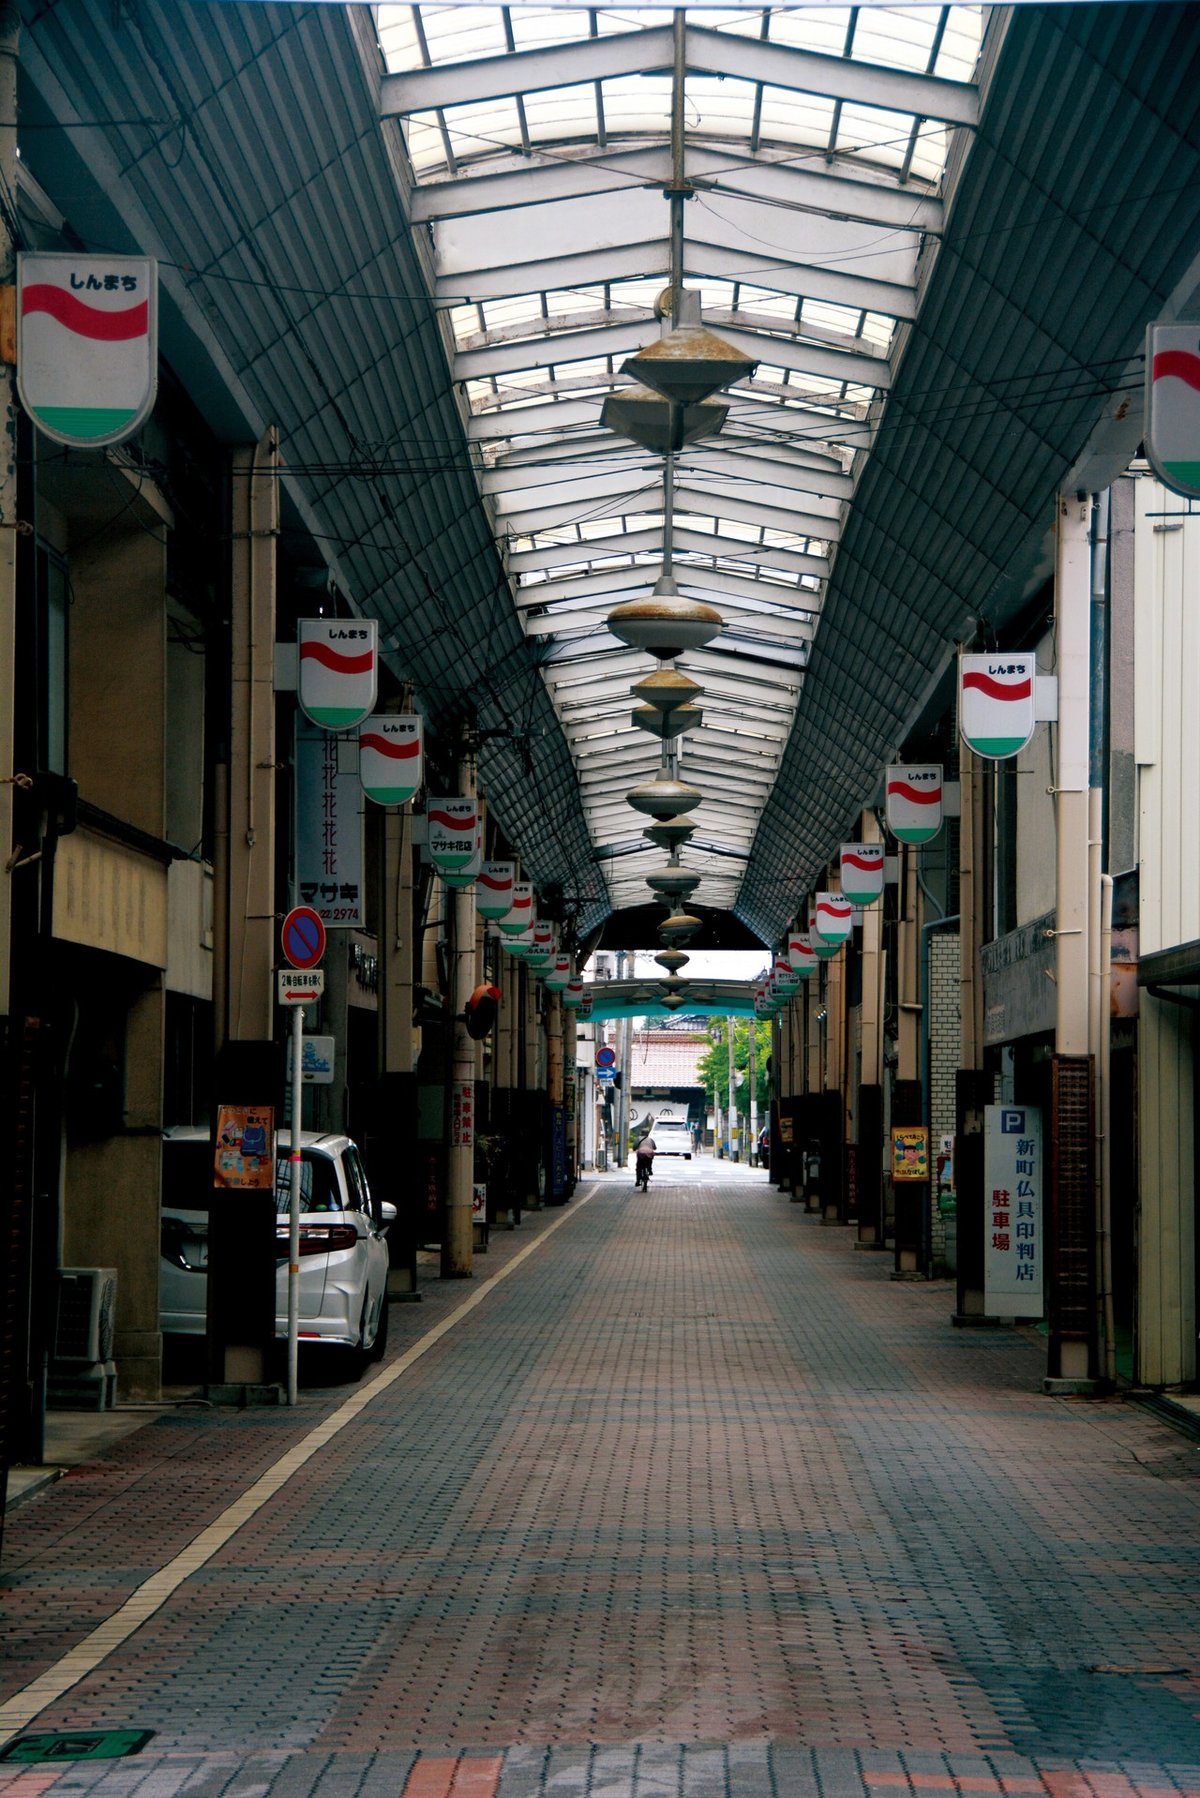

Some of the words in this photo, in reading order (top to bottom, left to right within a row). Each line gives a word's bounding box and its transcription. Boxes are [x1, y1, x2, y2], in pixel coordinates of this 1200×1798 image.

[70, 272, 137, 292] しんまち
[329, 629, 368, 640] しんまち
[988, 663, 1026, 675] しんまち
[383, 723, 416, 733] しんまち
[907, 772, 937, 781] しんまち
[431, 840, 473, 851] マサキ花店
[857, 848, 880, 856] しんまち
[300, 882, 358, 903] マサキ
[333, 908, 359, 920] 2974
[1015, 1138, 1035, 1282] 新町仏具印判店
[991, 1189, 1010, 1252] 駐車場
